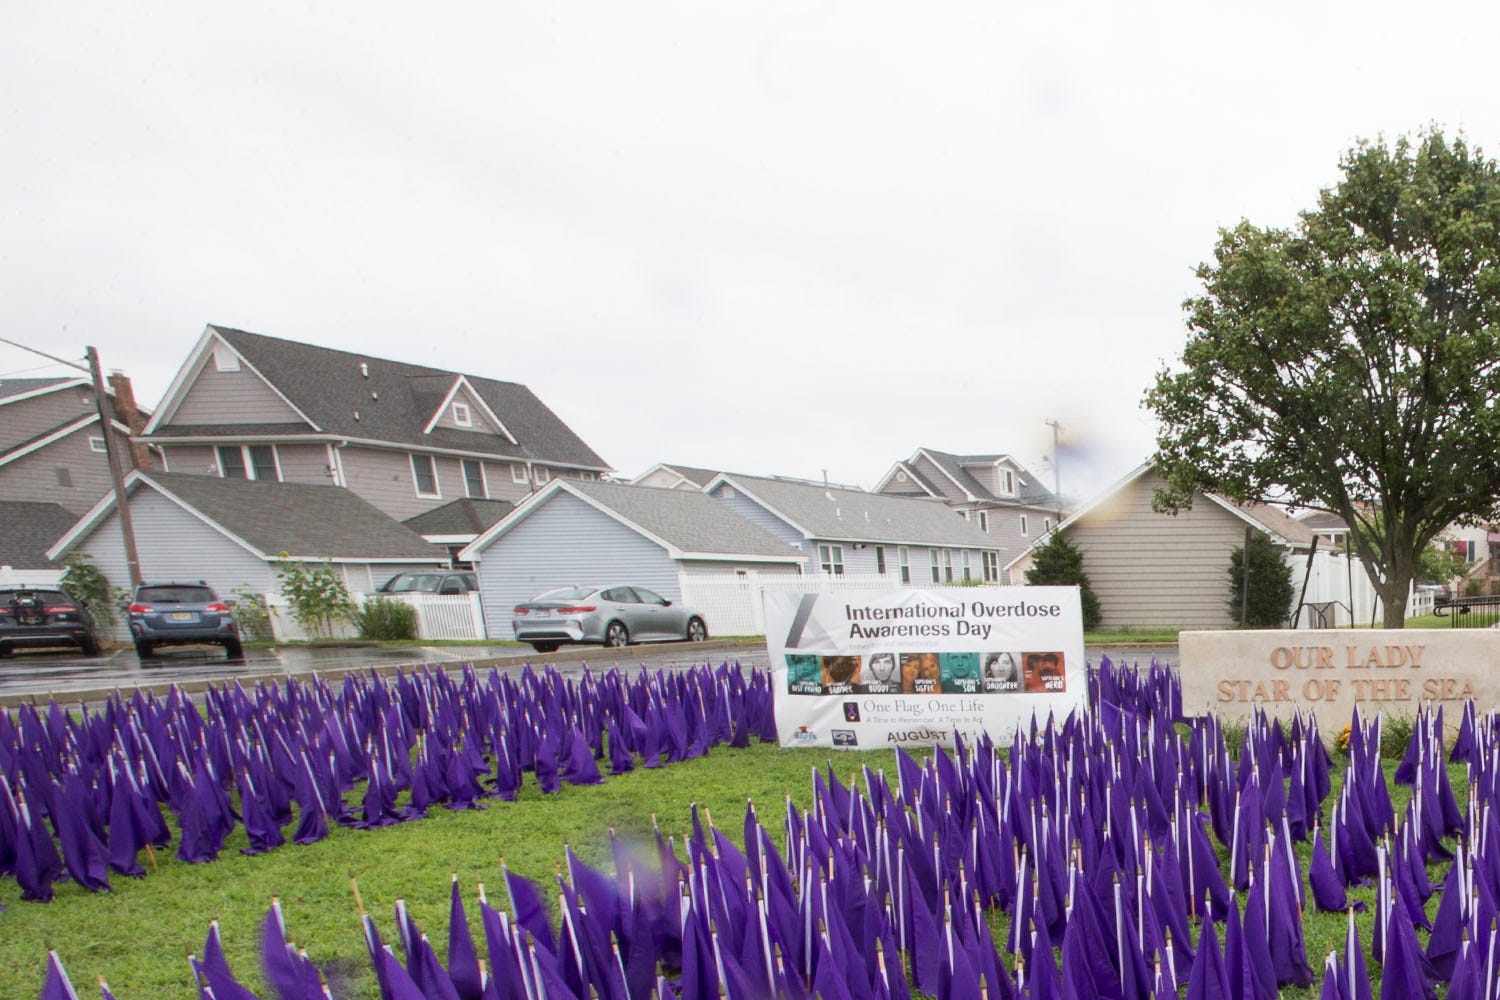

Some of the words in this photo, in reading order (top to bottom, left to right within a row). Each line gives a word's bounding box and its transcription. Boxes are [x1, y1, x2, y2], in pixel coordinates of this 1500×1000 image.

[845, 602, 966, 621] International
[971, 600, 1061, 618] Overdose
[849, 622, 950, 639] Awareness
[956, 620, 992, 640] Day
[1270, 645, 1336, 670] OUR
[1346, 644, 1426, 669] LADY
[962, 684, 977, 693] SON
[986, 681, 1018, 690] DAUGHTER
[1216, 679, 1293, 702] STAR
[1303, 678, 1342, 702] OF
[1351, 678, 1411, 701] THE
[1422, 677, 1479, 701] SEA
[863, 699, 891, 713] One
[928, 699, 956, 713] One
[960, 699, 985, 713] Life
[887, 729, 948, 743] AUGUST
